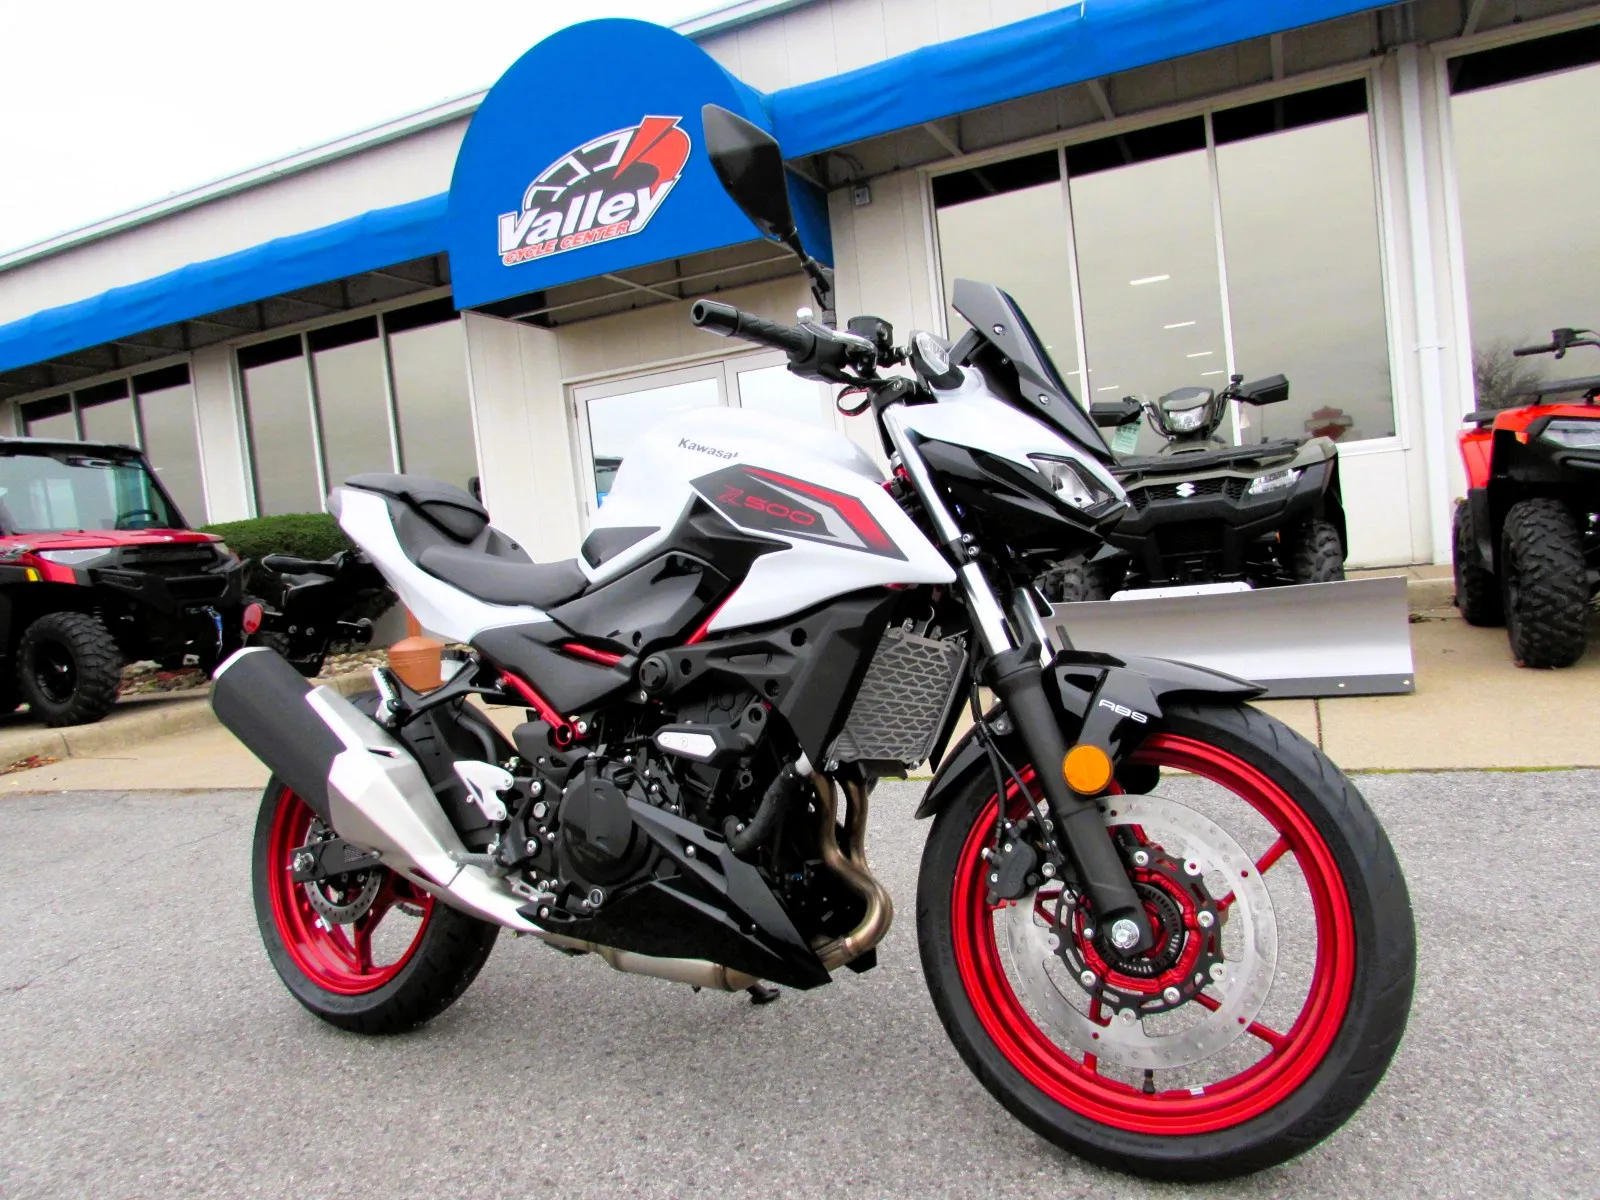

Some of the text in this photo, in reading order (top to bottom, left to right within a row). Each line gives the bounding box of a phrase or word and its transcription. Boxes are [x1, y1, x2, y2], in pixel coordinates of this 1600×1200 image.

[500, 180, 675, 252] Valley
[504, 221, 629, 264] CYCLE CENTER
[1099, 699, 1147, 723] ABS
